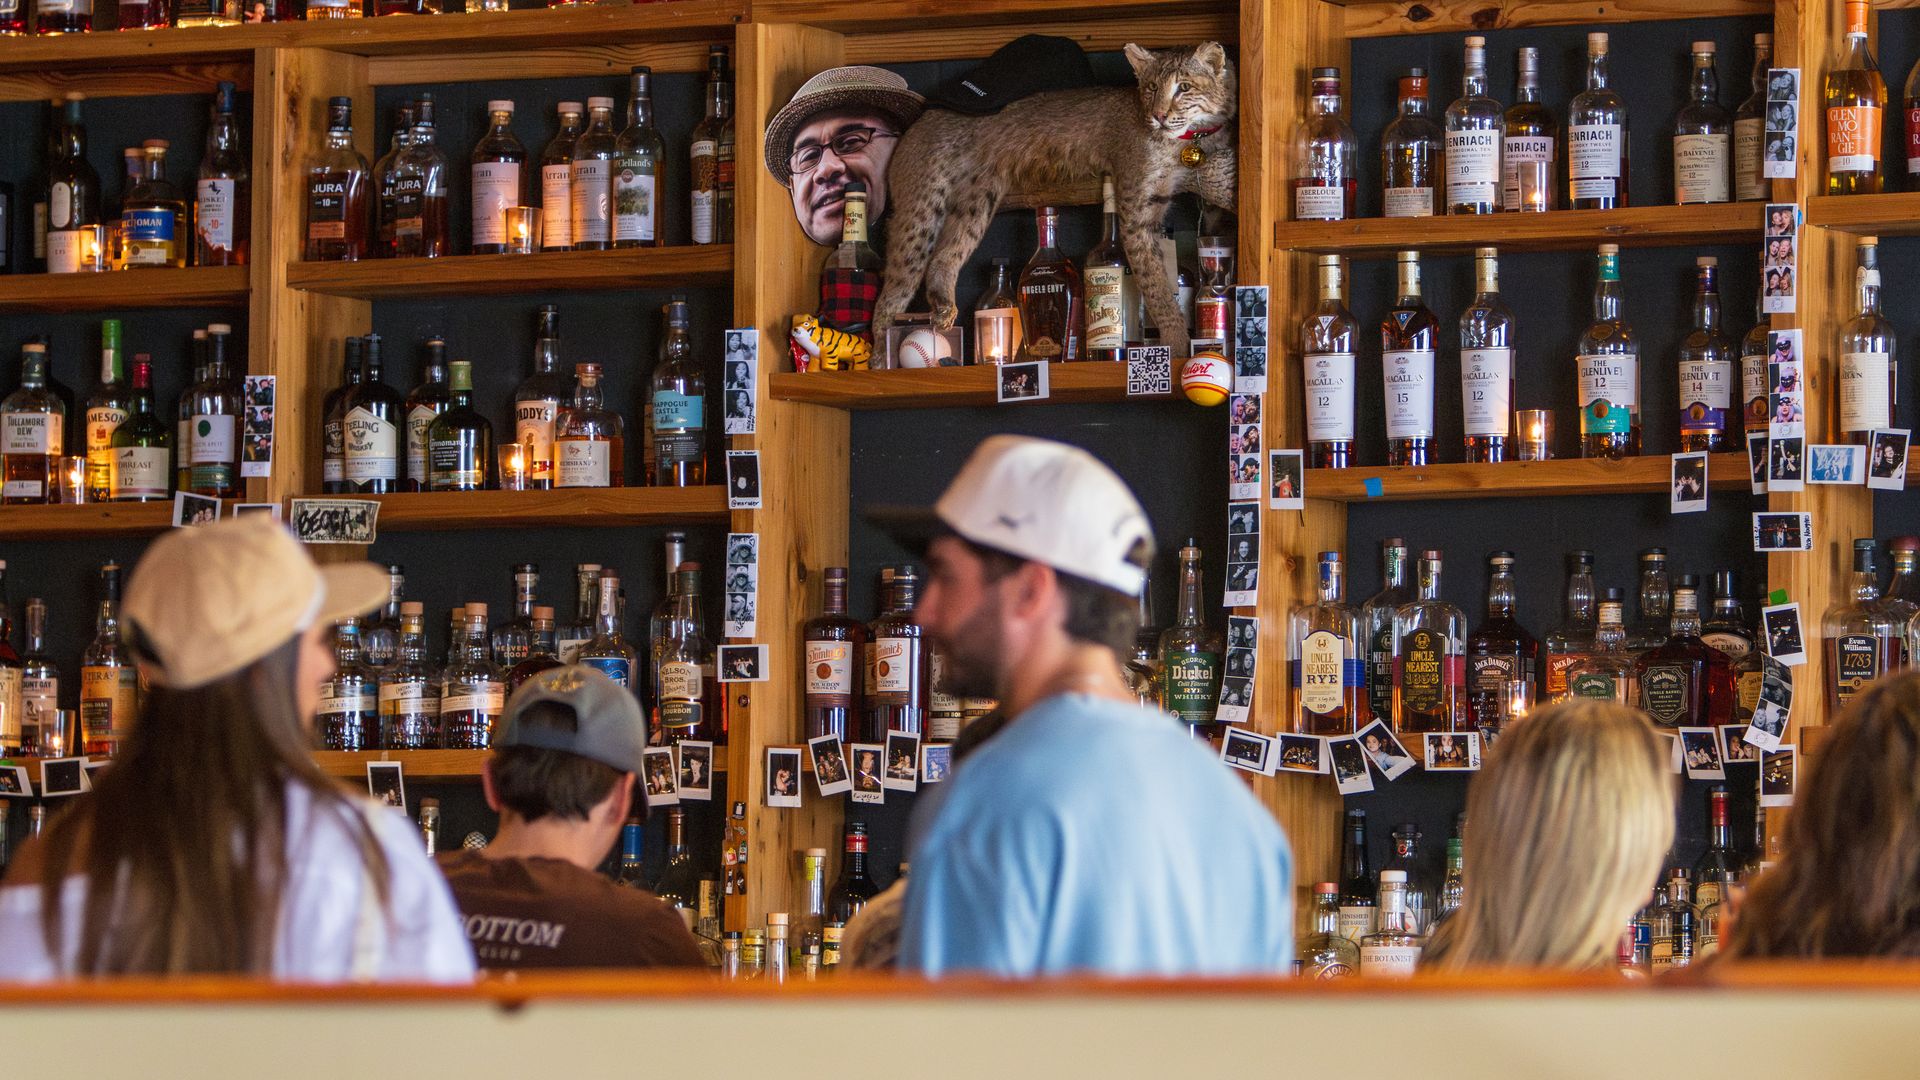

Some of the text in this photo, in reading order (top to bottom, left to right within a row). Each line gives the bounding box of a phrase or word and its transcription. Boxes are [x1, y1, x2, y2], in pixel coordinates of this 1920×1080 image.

[1830, 109, 1856, 121] GLEN
[1837, 121, 1858, 132] MO
[1831, 133, 1850, 144] RAN
[1507, 142, 1547, 153] NRIACH
[1837, 142, 1855, 153] GIE
[1581, 160, 1589, 168] 12
[1461, 165, 1469, 174] 10
[312, 183, 344, 193] JURA
[396, 180, 421, 191] JURA
[382, 187, 395, 196] JU
[322, 198, 330, 207] 10
[211, 219, 220, 229] 10
[1088, 304, 1122, 323] hiskey
[1593, 361, 1607, 369] THE
[1690, 365, 1703, 373] THE
[1595, 378, 1605, 388] 12
[1754, 376, 1764, 386] 15
[1692, 382, 1702, 392] 14
[1397, 393, 1409, 403] 15
[1473, 391, 1484, 401] 12
[1318, 396, 1330, 407] 12
[8, 415, 45, 427] TULLAMORE
[87, 412, 126, 424] AMESON
[325, 424, 343, 436] TEELI
[345, 419, 379, 433] TEELING
[17, 427, 33, 436] DEW
[661, 444, 672, 452] 12
[118, 461, 152, 469] DBREAST
[123, 477, 134, 486] 12
[1848, 637, 1866, 645] Evan
[1310, 652, 1329, 663] UNCLE
[1373, 651, 1392, 663] NEAR
[1410, 650, 1434, 661] UNCLE
[1844, 653, 1872, 668] 1783
[1181, 656, 1207, 666] GEORGE
[1474, 656, 1511, 671] JACK DANIEL'S
[1553, 659, 1566, 671] JACK
[662, 667, 691, 677] NELSON
[1172, 665, 1213, 680] Dickel
[1306, 663, 1338, 674] NEAREST
[1376, 663, 1392, 674] GREE
[1405, 662, 1439, 673] NEAREST
[39, 680, 51, 688] GAY
[1306, 674, 1337, 684] RYE
[1582, 680, 1590, 689] JACK
[663, 707, 691, 715] BOURBON
[463, 914, 566, 948] OTTOM
[1374, 954, 1411, 963] BOTANIST
